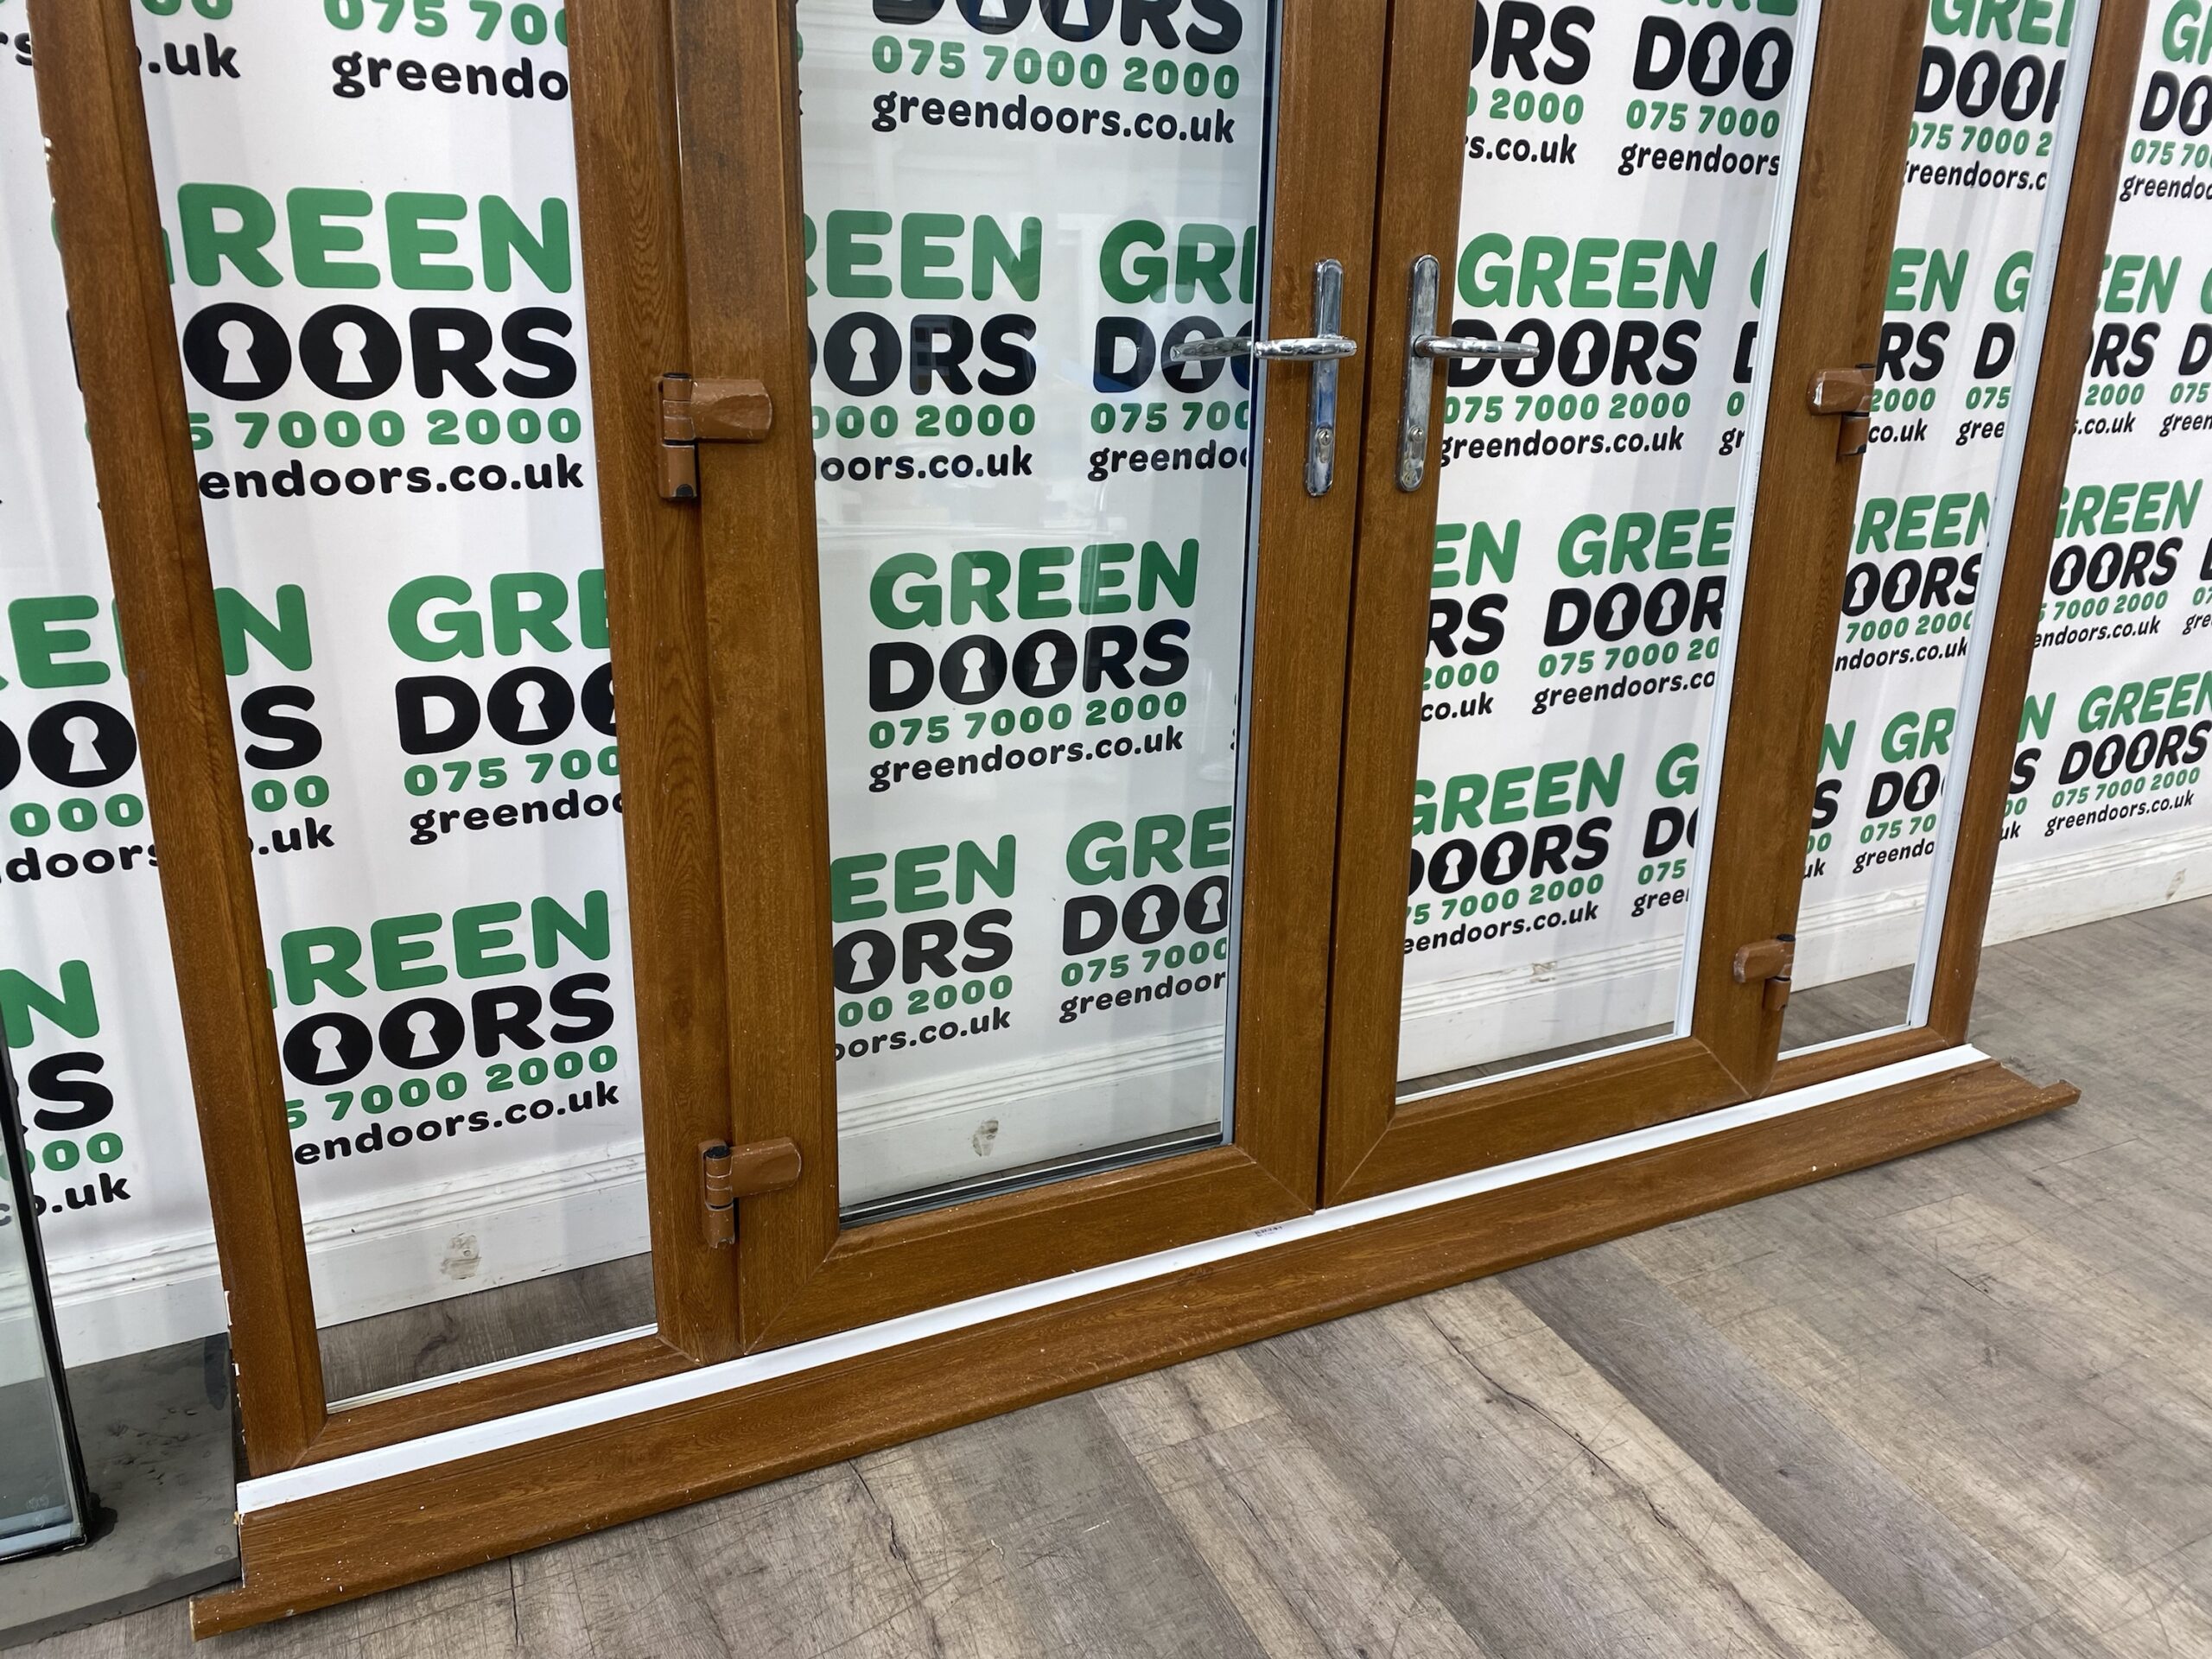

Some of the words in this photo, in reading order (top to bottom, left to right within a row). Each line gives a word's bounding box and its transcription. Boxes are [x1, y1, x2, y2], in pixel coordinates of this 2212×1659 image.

[323, 0, 448, 37] 075
[136, 32, 241, 78] .uk
[332, 51, 569, 100] greendo
[872, 35, 965, 79] 075
[983, 45, 1107, 89] 7000
[1123, 57, 1240, 99] 2000
[1633, 16, 1793, 101] DOO
[871, 91, 1236, 143] greendoors.co.uk
[1490, 88, 1584, 125] 2000
[1626, 99, 1688, 131] 075
[1698, 105, 1780, 138] 7000
[1465, 133, 1577, 164] s.co.uk
[1618, 143, 1780, 175] greendoors
[1961, 126, 2031, 156] 7000
[2131, 138, 2176, 165] 075
[2181, 143, 2212, 168] 70
[1904, 160, 2048, 190] reendoors.c
[162, 181, 572, 293] REEN
[804, 209, 1042, 302] EEN
[1099, 219, 1256, 304] GR
[1458, 232, 1717, 309] GREEN
[182, 302, 577, 401] OORS
[808, 311, 1037, 397] ORS
[1447, 319, 1701, 387] DOORS
[1974, 322, 2018, 379] D
[2086, 321, 2161, 377] RS
[1090, 402, 1167, 433] 075
[1443, 396, 1503, 423] 075
[1516, 393, 1599, 422] 7000
[1609, 391, 1691, 419] 2000
[1966, 386, 2012, 410] 075
[2084, 383, 2145, 405] 2000
[2170, 382, 2211, 404] 075
[235, 409, 404, 448] 7000
[428, 408, 582, 445] 2000
[916, 404, 1035, 436] 2000
[812, 444, 1033, 481] oors.co.uk
[1440, 425, 1684, 467] greendoors.co.uk
[199, 454, 583, 499] endoors.co.uk
[1558, 506, 1735, 578] GREE
[1852, 491, 1990, 555] REEN
[869, 538, 1200, 630] GREEN
[2050, 537, 2183, 595] OORS
[1543, 575, 1727, 647] DOOR
[2053, 597, 2109, 620] 7000
[2113, 590, 2169, 613] 2000
[1834, 636, 1968, 671] ndoors.co.uk
[1846, 617, 1910, 644] 7000
[2034, 615, 2161, 648] endoors.co.uk
[868, 619, 1192, 712] DOORS
[1538, 650, 1595, 677] 075
[1605, 641, 1679, 671] 7000
[1531, 671, 1715, 715] greendoors.co
[869, 715, 950, 749] 075
[964, 703, 1071, 740] 7000
[1085, 691, 1186, 726] 2000
[404, 757, 508, 796] 075
[868, 726, 1183, 792] greendoors.co.uk
[2058, 720, 2212, 785] DOORS
[1412, 753, 1625, 836] GREEN
[1866, 764, 1946, 819] DO
[2052, 786, 2090, 809] 075
[2094, 776, 2145, 800] 7000
[2150, 766, 2201, 791] 2000
[1643, 806, 1699, 858] D
[1860, 820, 1903, 844] 075
[2044, 790, 2195, 836] greendoors.co.uk
[0, 844, 160, 883] door
[248, 817, 334, 855] .uk
[1066, 805, 1232, 886] GRE
[1853, 838, 1935, 874] greendo
[830, 835, 1016, 924] EEN
[1638, 858, 1688, 885] 075
[1063, 875, 1230, 956] DOO
[1441, 888, 1519, 920] 7000
[1529, 874, 1604, 906] 2000
[1631, 887, 1689, 917] gree
[266, 889, 611, 1009] REEN
[833, 908, 1014, 995] ORS
[1404, 900, 1599, 954] eendoors.co.uk
[907, 975, 1013, 1015] 2000
[1061, 955, 1129, 987] 075
[1058, 971, 1226, 1024] greendoor
[283, 972, 614, 1086] OORS
[325, 1071, 467, 1121] 7000
[485, 1045, 618, 1092] 2000
[294, 1080, 620, 1165] endoors.co.uk
